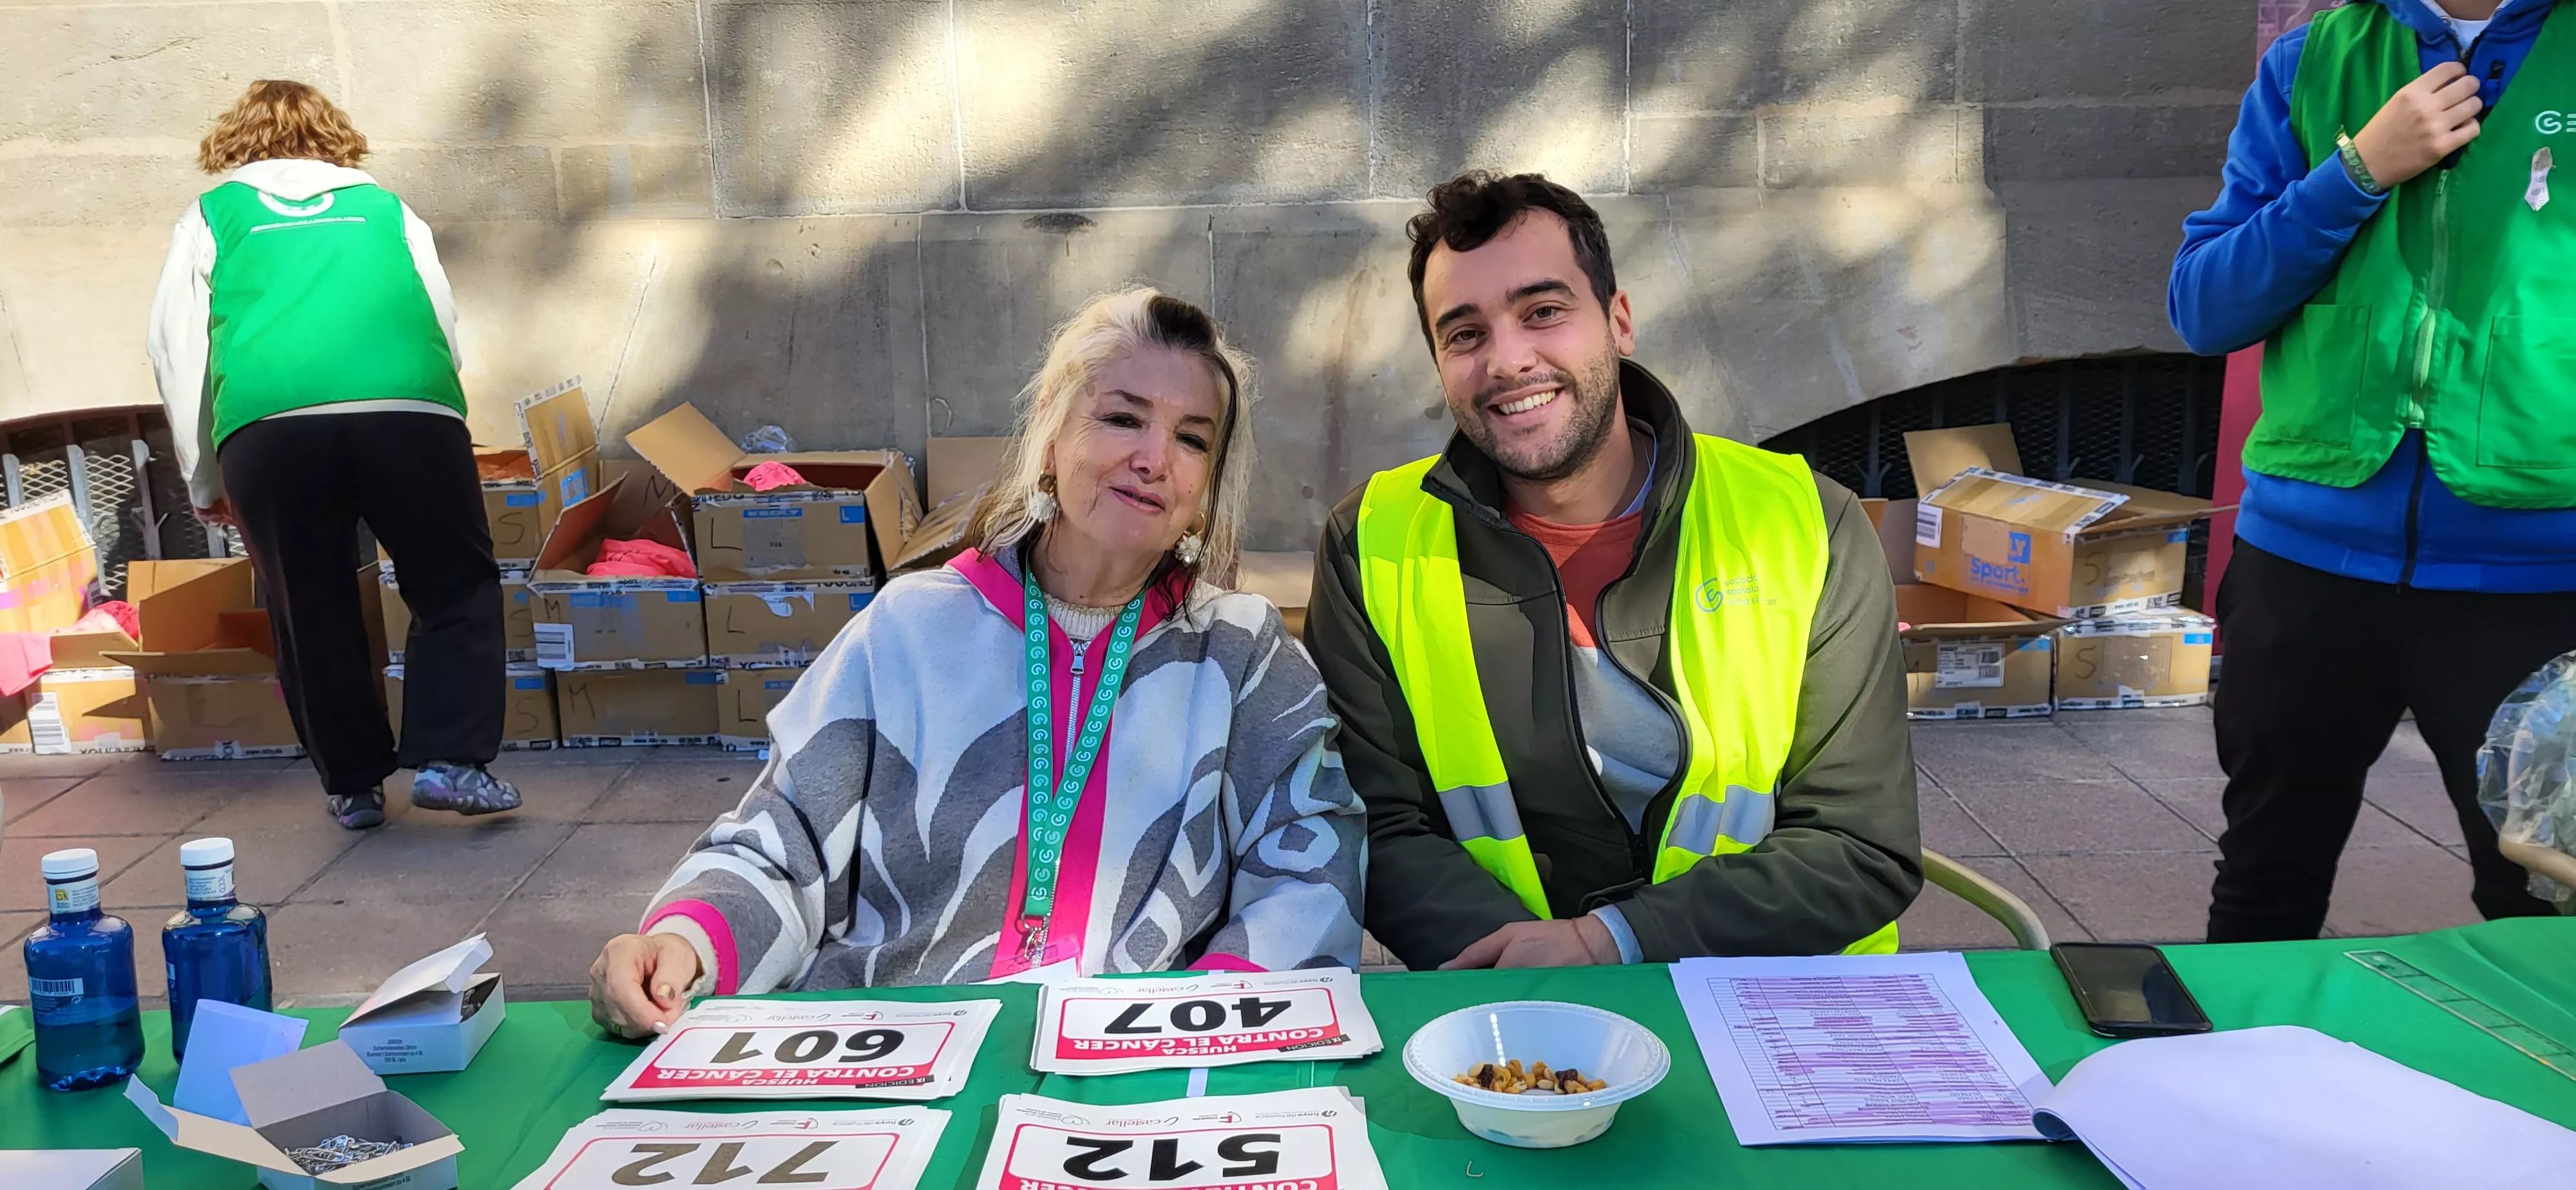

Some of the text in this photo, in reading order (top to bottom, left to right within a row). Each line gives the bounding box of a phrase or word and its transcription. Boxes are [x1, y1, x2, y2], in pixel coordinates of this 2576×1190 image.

[498, 511, 526, 545] S
[710, 517, 743, 551] L
[2085, 551, 2103, 585] S
[544, 598, 562, 622] M
[727, 606, 746, 634] L
[2076, 645, 2097, 680] S
[513, 696, 539, 734] S
[567, 683, 596, 719] M
[737, 688, 758, 723] L
[1104, 997, 1292, 1034] 407
[708, 1029, 905, 1064] 601
[1072, 1028, 1325, 1052] CONTRA EL CÁNCER
[1162, 1044, 1237, 1055] HUESCA
[656, 1066, 916, 1082] CONTRA EL CÁNCER
[741, 1077, 819, 1086] HUESCA
[684, 1121, 740, 1130] castellar
[1104, 1118, 1162, 1127] castellar
[611, 1140, 841, 1186] 712
[1063, 1133, 1282, 1181] 512
